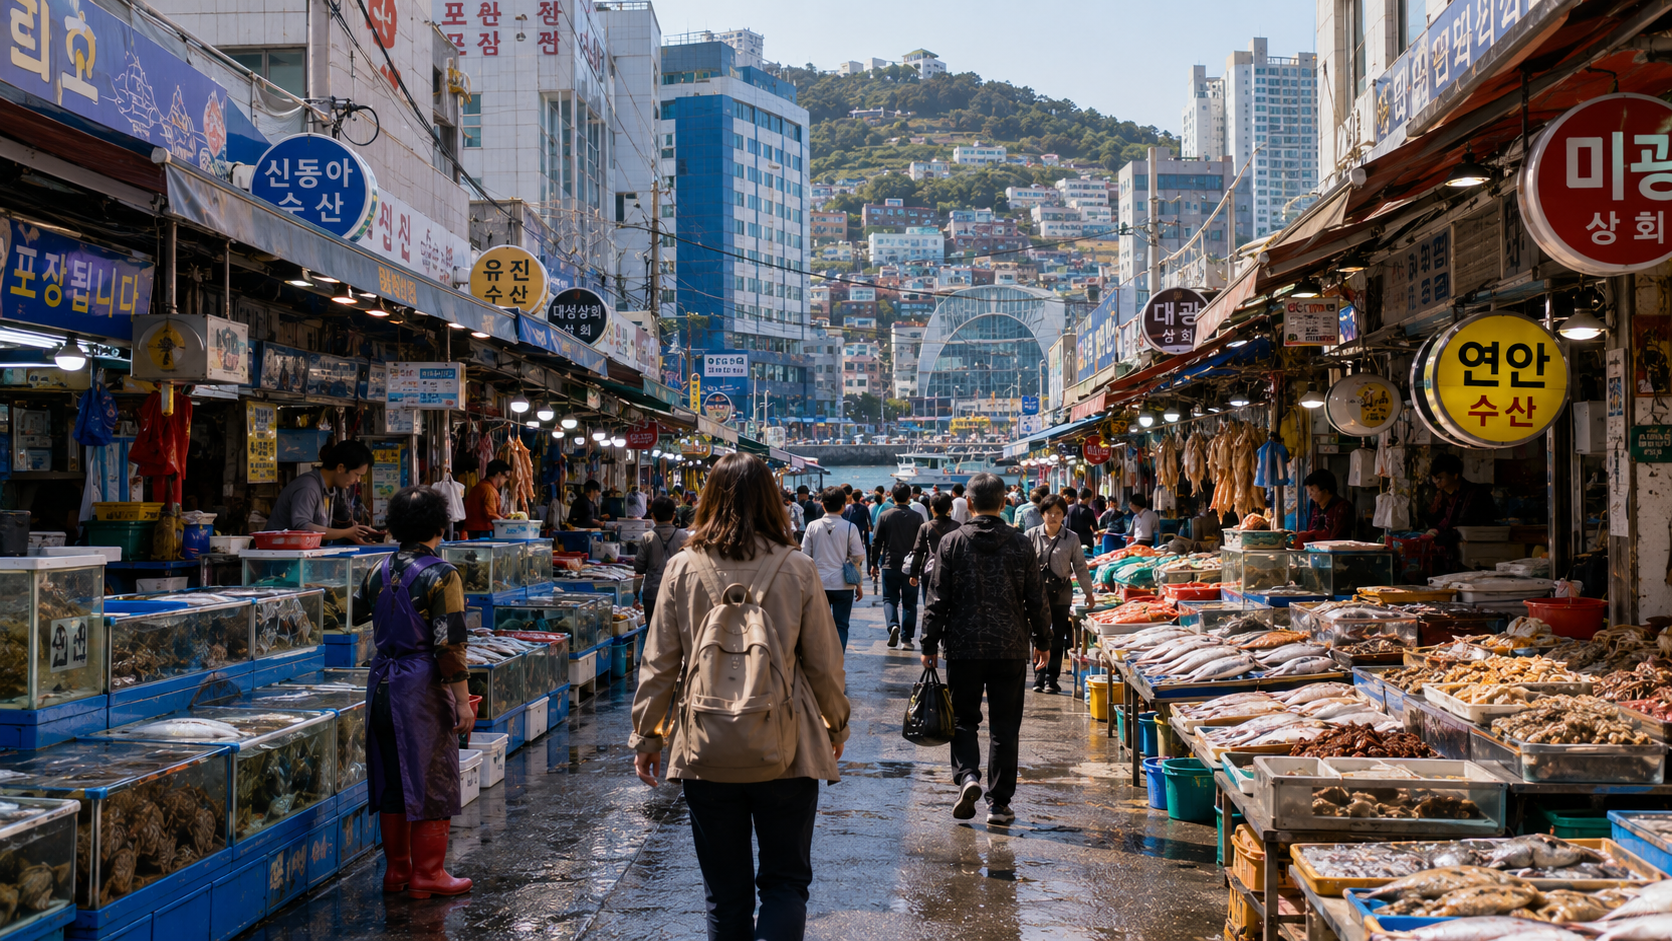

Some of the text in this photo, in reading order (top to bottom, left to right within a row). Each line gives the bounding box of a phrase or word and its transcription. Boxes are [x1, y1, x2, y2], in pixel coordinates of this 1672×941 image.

[265, 158, 353, 188] 신동아
[278, 192, 344, 223] 수산
[1585, 211, 1665, 245] 상회
[10, 245, 139, 322] 포장됩니다
[483, 259, 530, 282] 유진
[484, 285, 529, 305] 수산
[553, 304, 601, 319] 대성상회
[1153, 301, 1202, 326] 대광
[1162, 328, 1193, 343] 상회
[1458, 340, 1550, 389] 연안
[1468, 394, 1537, 428] 수산
